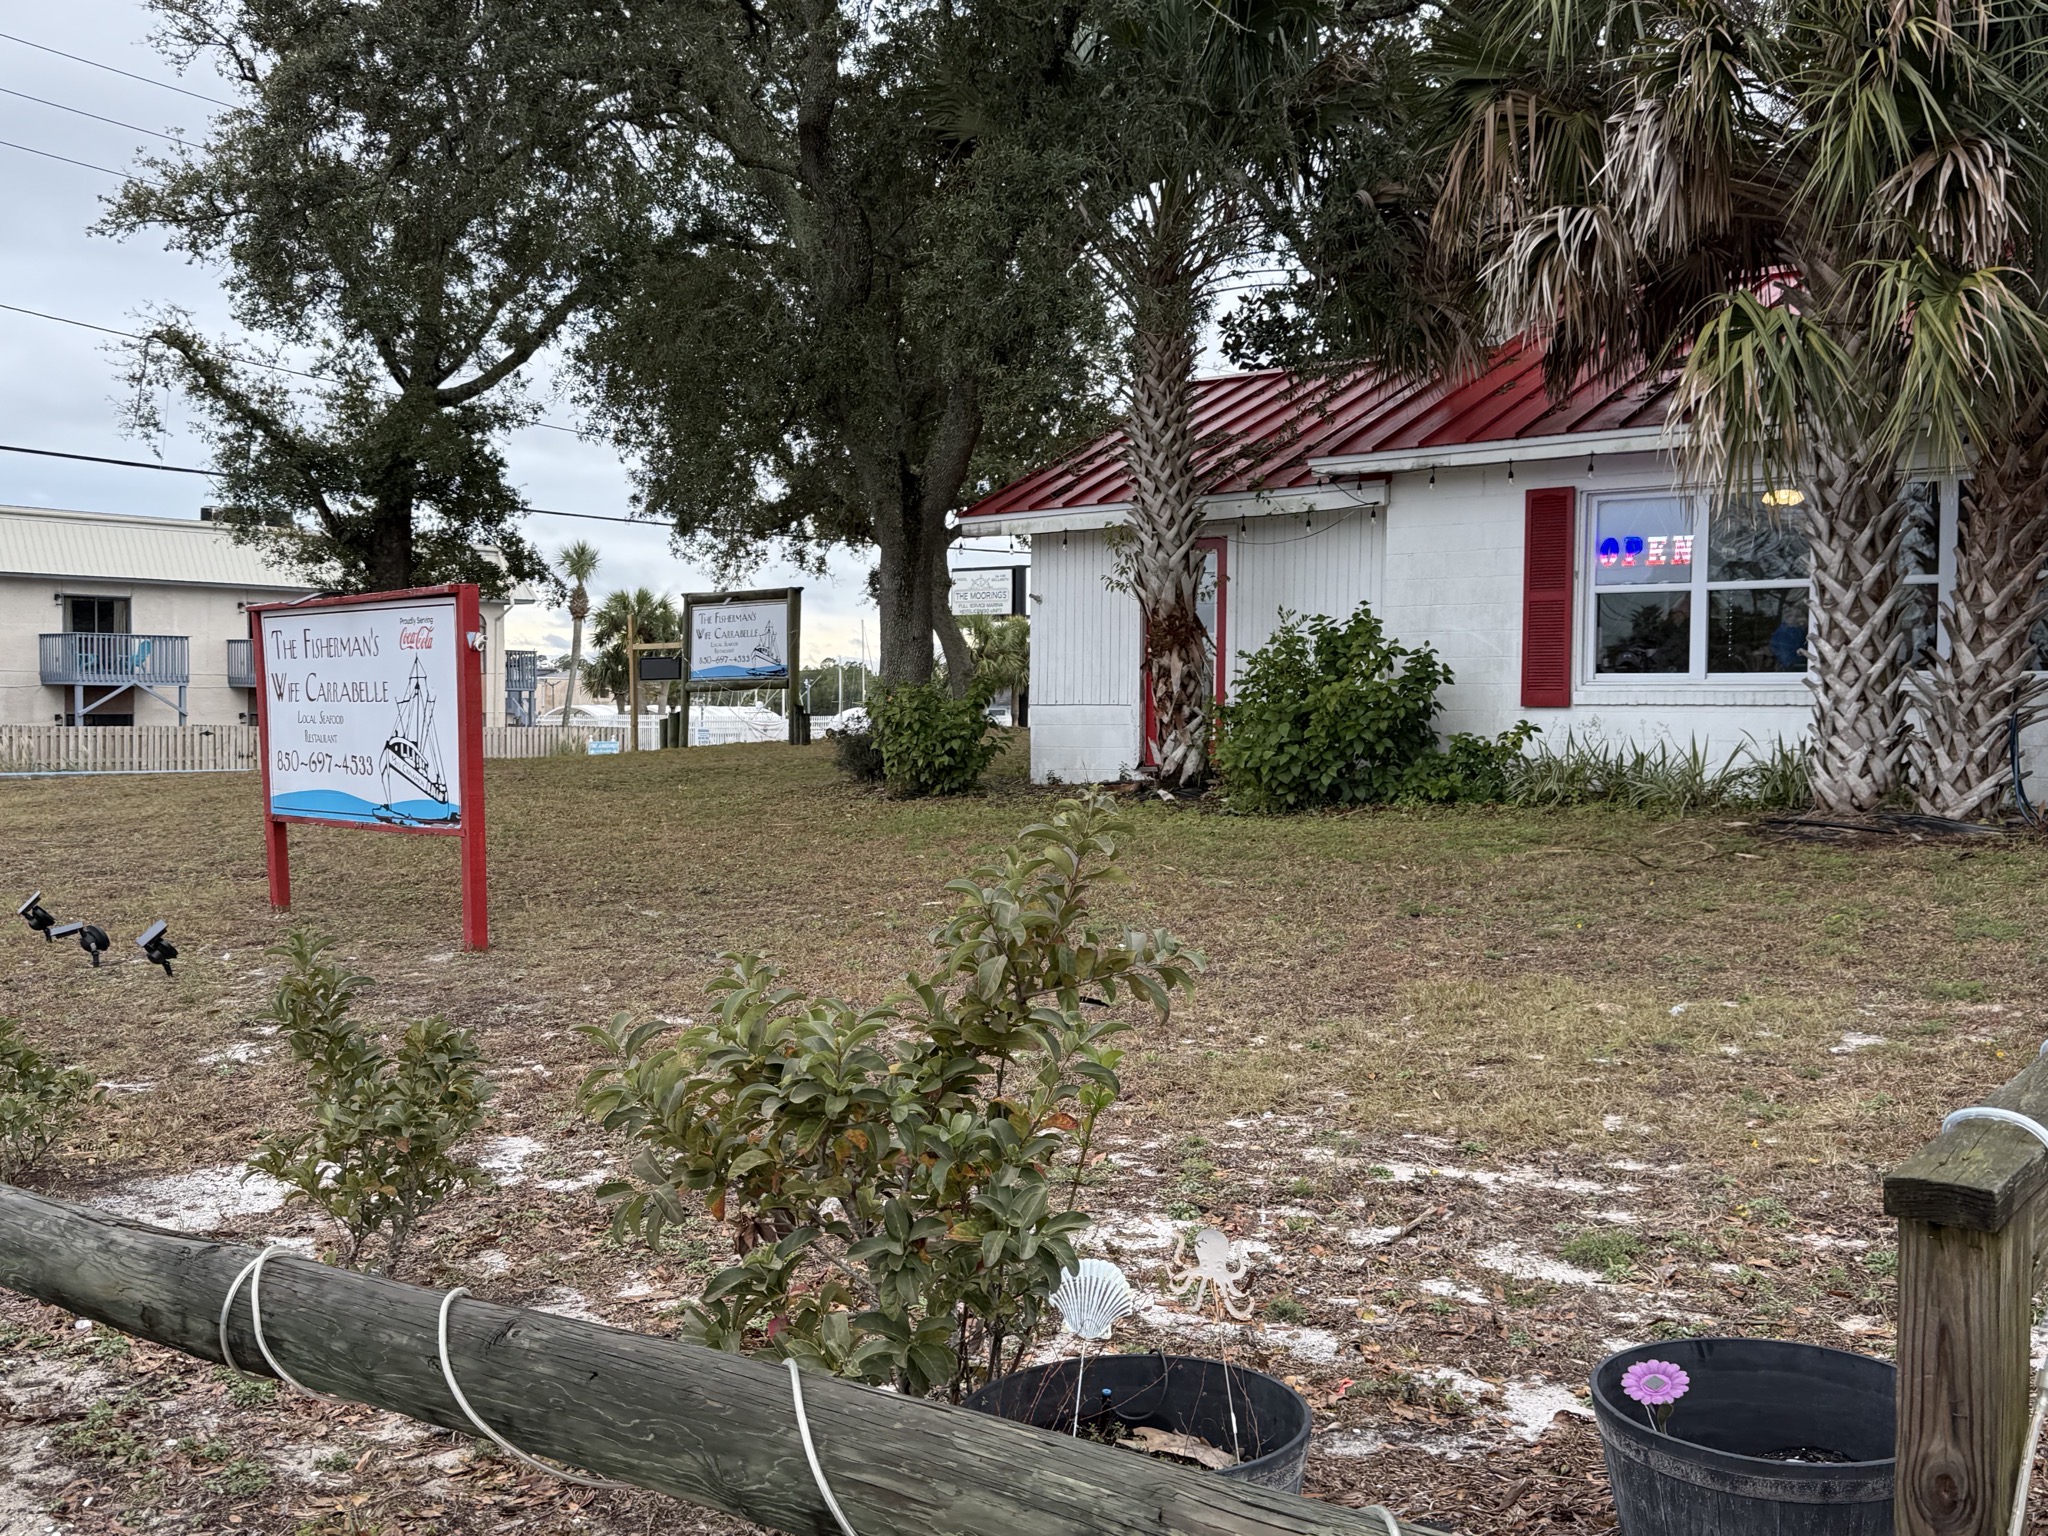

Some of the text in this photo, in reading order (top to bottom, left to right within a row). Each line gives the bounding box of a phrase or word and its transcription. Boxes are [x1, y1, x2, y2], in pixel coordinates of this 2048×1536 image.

[1600, 535, 1695, 568] OPEN
[956, 591, 1007, 600] THE MOORINGS
[416, 616, 434, 625] Serving
[698, 611, 757, 624] THE FISHERMAN'S
[696, 627, 758, 640] WIFE CARRABELLE
[271, 627, 380, 660] THE FISHERMAN'S
[271, 672, 389, 702] WIFE CARRABELLE
[297, 710, 345, 725] LOCAL SEAFOOD
[304, 729, 338, 743] RESTAURANT
